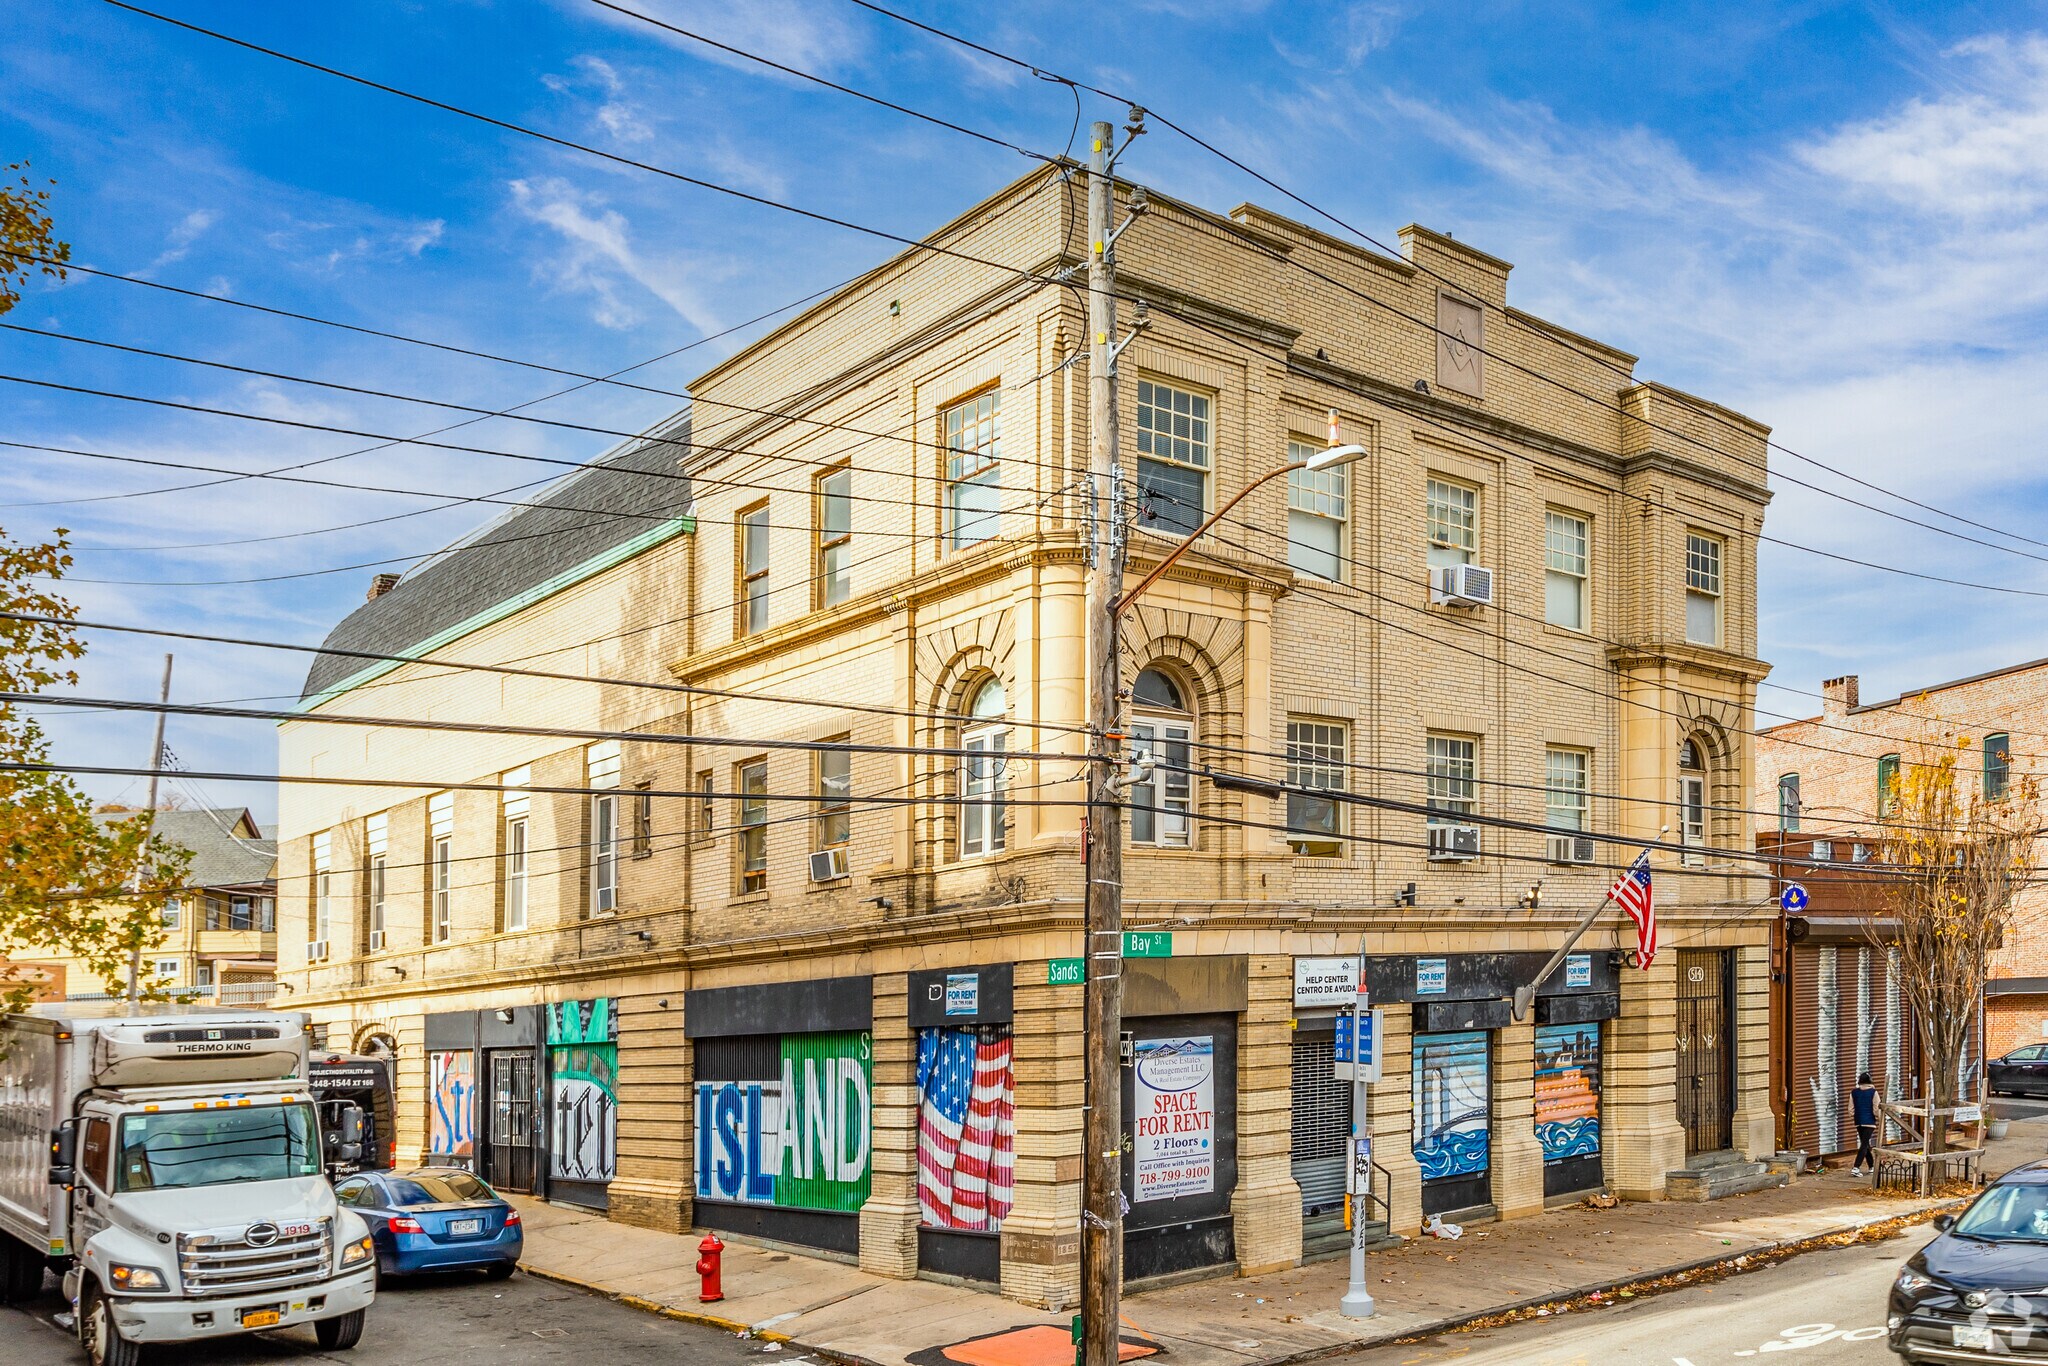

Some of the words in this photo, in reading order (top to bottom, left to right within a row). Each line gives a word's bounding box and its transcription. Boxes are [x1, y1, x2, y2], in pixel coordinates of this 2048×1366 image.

[1131, 934, 1150, 955] Bay
[1154, 934, 1162, 945] St
[1051, 963, 1078, 981] Sands
[1418, 973, 1430, 981] FOR
[1430, 972, 1445, 981] RENT
[1568, 967, 1577, 975] FOR
[1690, 969, 1701, 980] 514
[1306, 976, 1323, 984] HELP
[1324, 975, 1349, 983] CENTER
[947, 990, 960, 1000] FOR
[961, 990, 976, 999] RENT
[1297, 986, 1323, 994] CENTRO
[1324, 985, 1333, 993] DE
[1334, 985, 1357, 993] AYUDA
[177, 1044, 223, 1052] THERMO
[226, 1043, 251, 1051] KING
[1154, 1058, 1178, 1066] Diverse
[1179, 1056, 1201, 1065] Estates
[1150, 1066, 1190, 1077] Management
[1191, 1064, 1205, 1073] LLC
[1154, 1092, 1198, 1114] SPACE
[699, 1057, 871, 1200] ISLAND
[1138, 1115, 1169, 1137] FOR
[1173, 1111, 1211, 1133] RENT
[1153, 1139, 1160, 1150] 2
[1164, 1137, 1199, 1149] Floors
[335, 1165, 360, 1173] Project
[1140, 1163, 1152, 1171] Call
[1185, 1157, 1210, 1166] Inquiries
[1139, 1166, 1210, 1185] 718-799-9100
[1142, 1179, 1207, 1192] www.DiverseEstates.com
[285, 1224, 310, 1235] 1919
[1058, 1244, 1078, 1255] 1857
